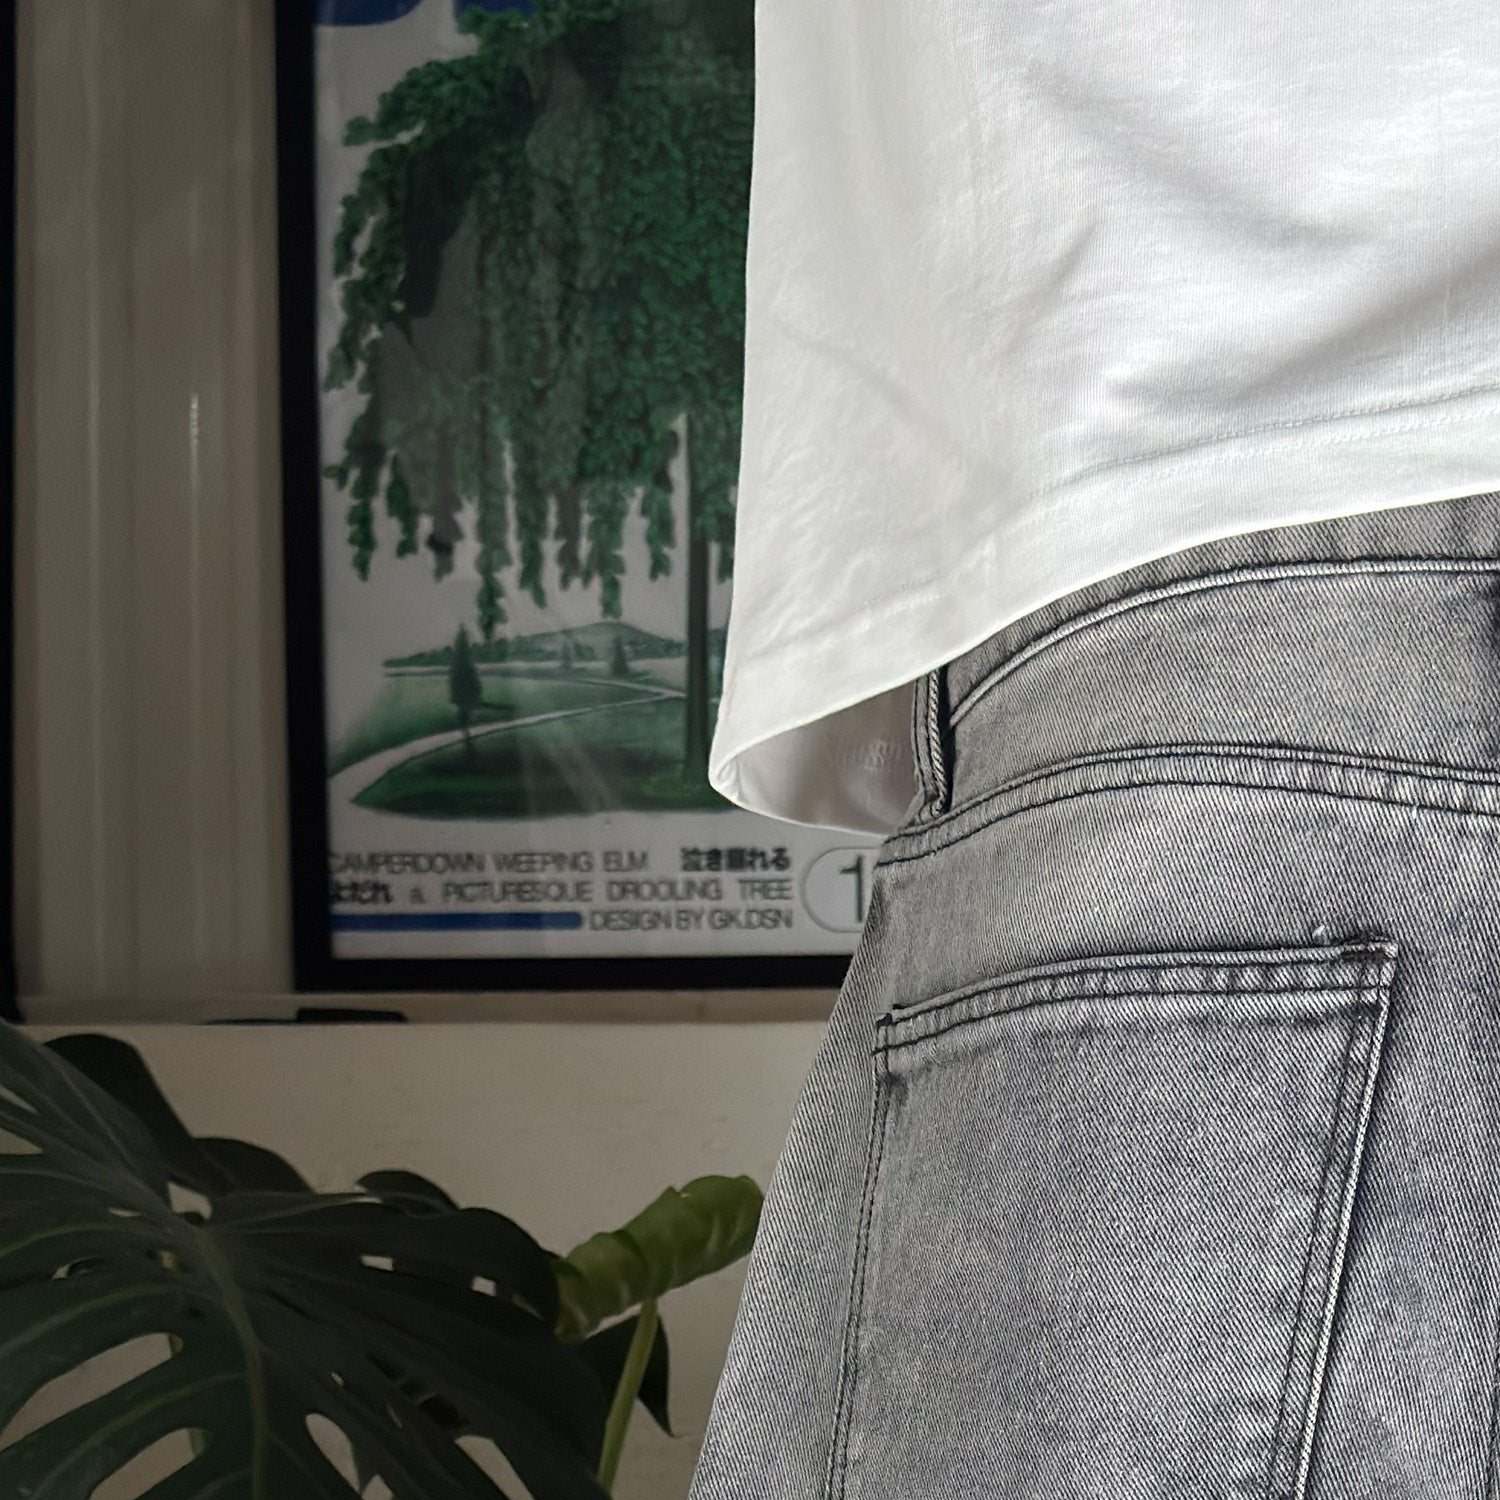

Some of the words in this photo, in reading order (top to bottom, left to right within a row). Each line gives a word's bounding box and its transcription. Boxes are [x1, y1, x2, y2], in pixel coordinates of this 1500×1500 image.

[494, 850, 594, 873] WEEPING
[603, 851, 648, 872] ELM
[738, 878, 793, 901] TREE
[589, 908, 671, 931] DESIGN
[675, 908, 704, 931] BY
